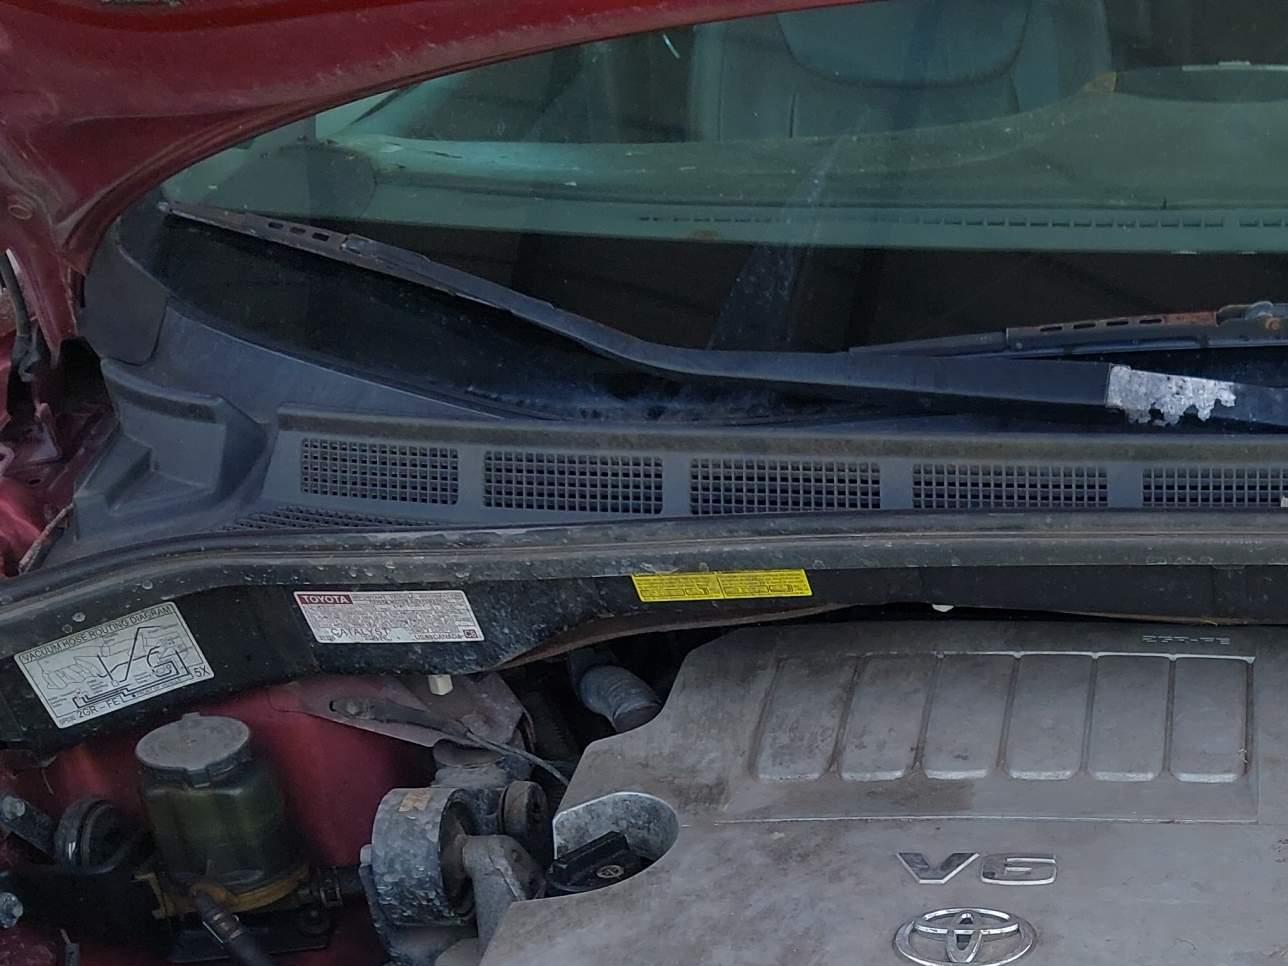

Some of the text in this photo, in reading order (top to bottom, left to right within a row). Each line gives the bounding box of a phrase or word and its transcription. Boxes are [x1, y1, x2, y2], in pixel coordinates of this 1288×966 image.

[303, 595, 349, 604] TOYOTA
[22, 605, 171, 661] VACUUM HOSE ROUTING DIAGRAM
[331, 627, 391, 637] CATALYST
[194, 667, 211, 678] 5X
[896, 852, 1057, 885] V6
